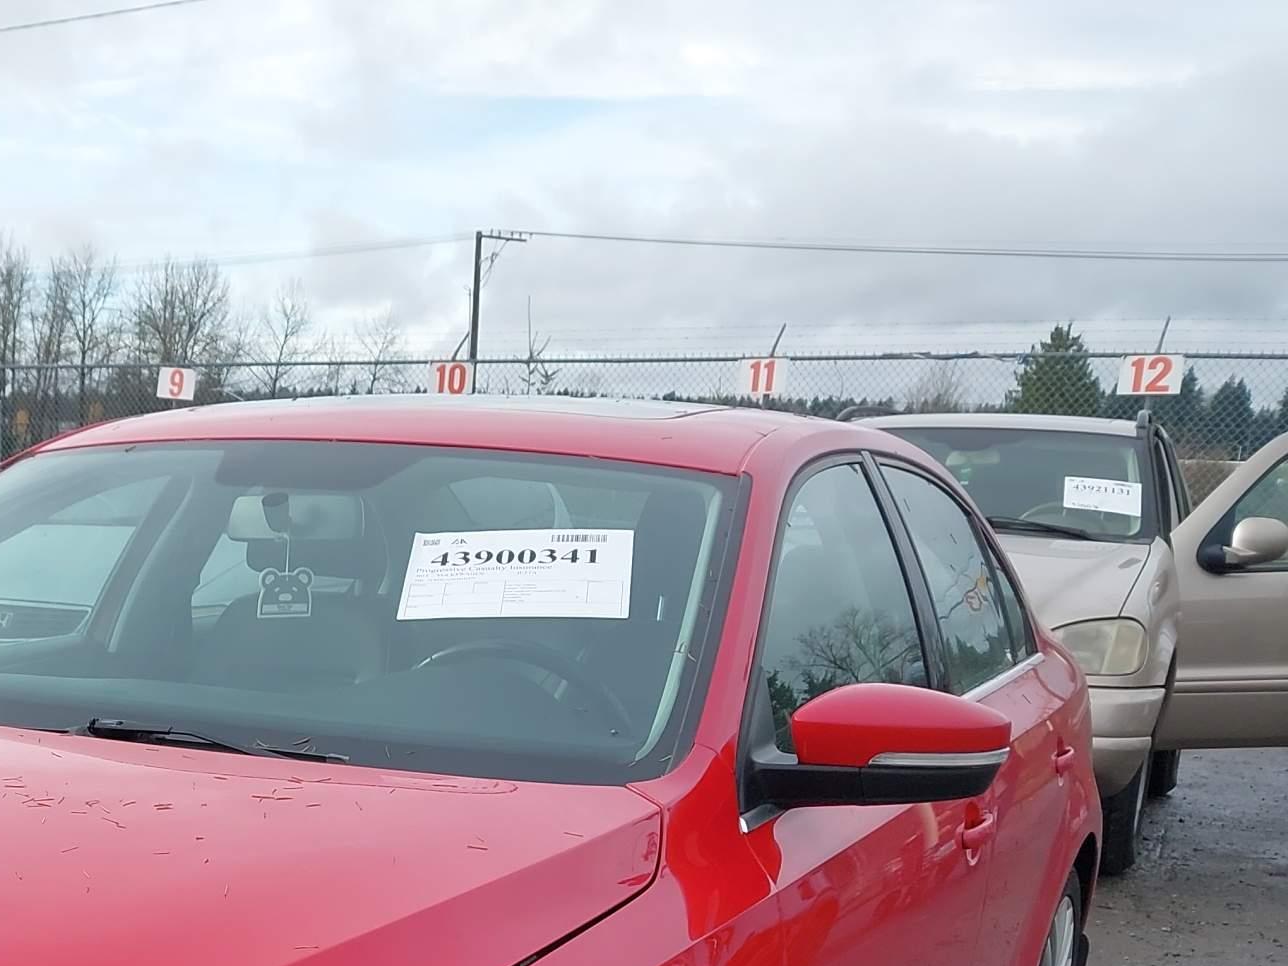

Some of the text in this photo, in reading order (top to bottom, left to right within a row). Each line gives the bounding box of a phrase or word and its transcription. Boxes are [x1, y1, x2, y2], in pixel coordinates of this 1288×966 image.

[168, 368, 185, 397] 9
[435, 363, 467, 394] 10
[749, 360, 778, 393] 11
[1130, 356, 1173, 393] 12
[430, 548, 601, 567] 43900341
